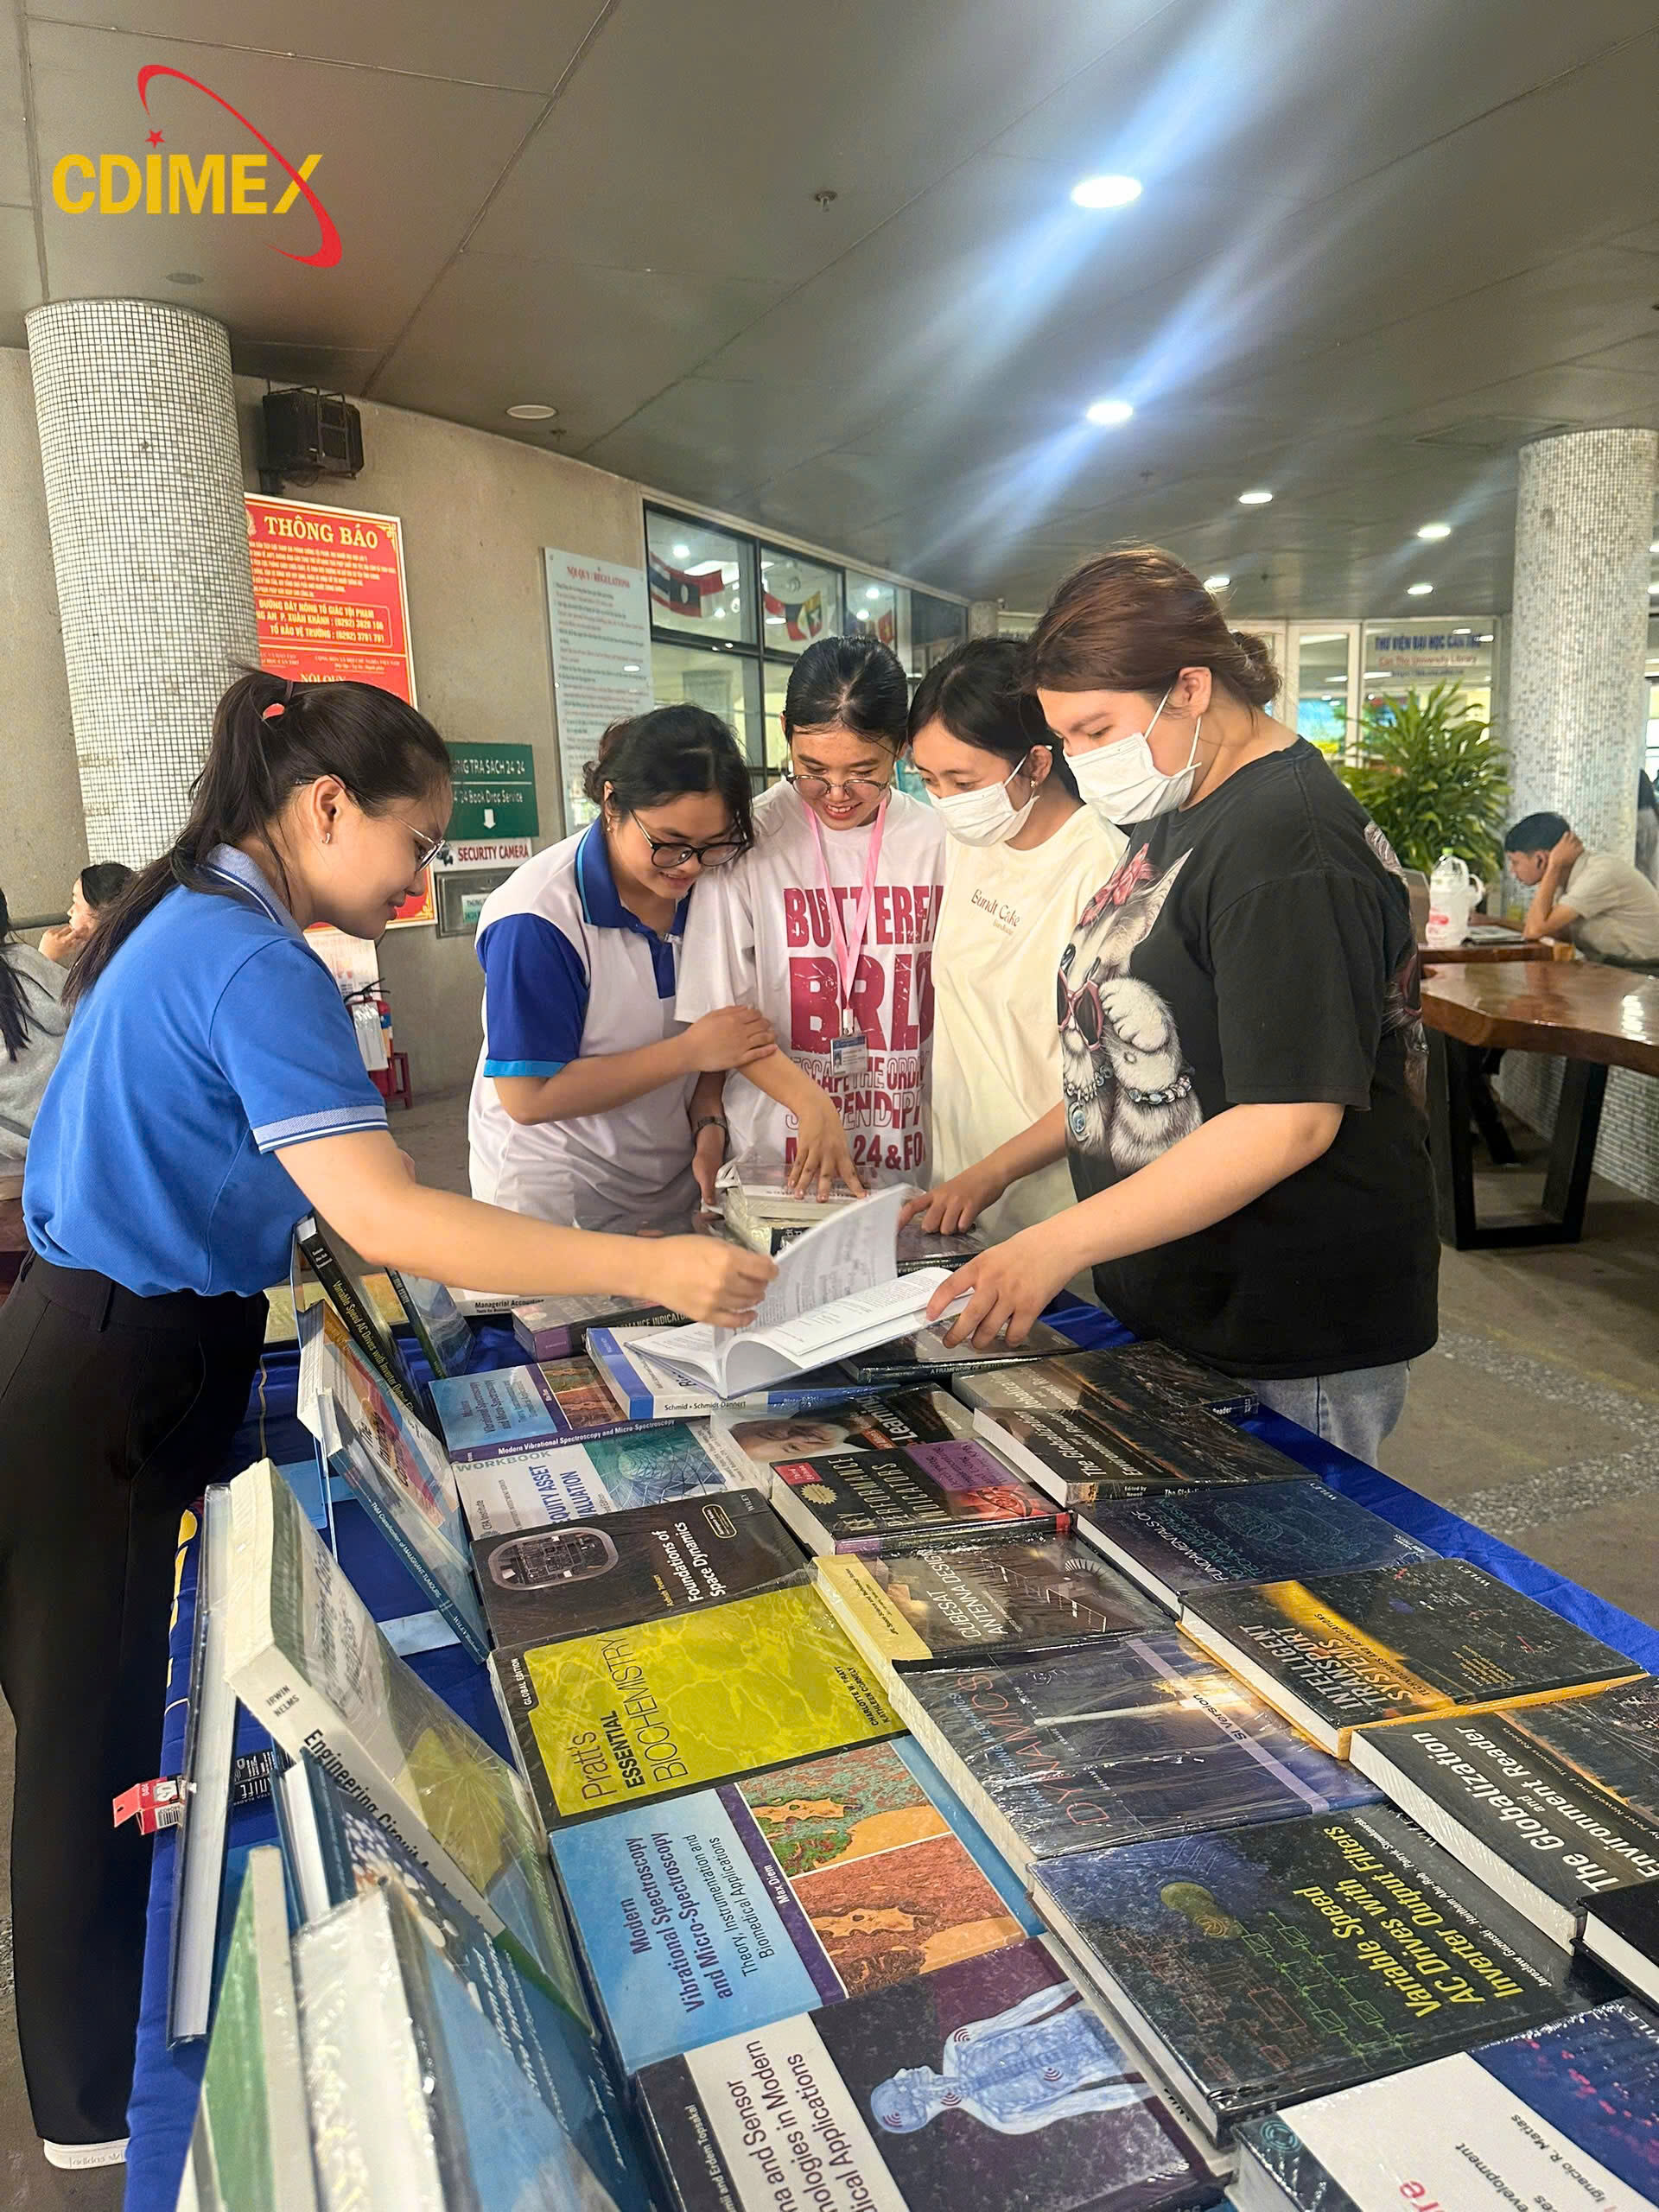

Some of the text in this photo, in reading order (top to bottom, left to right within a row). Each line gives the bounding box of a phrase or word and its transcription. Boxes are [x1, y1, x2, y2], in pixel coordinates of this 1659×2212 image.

[264, 515, 378, 550] THÔNG BÁO
[458, 844, 529, 861] SECURITY CAMERA
[474, 1299, 510, 1310] Managerial
[332, 1280, 349, 1306] Variable
[346, 1304, 359, 1325] Speed
[362, 1332, 376, 1351] Drives
[372, 1351, 383, 1363] with
[379, 1362, 396, 1387] Inverter
[664, 1402, 688, 1411] Schmid
[857, 1395, 918, 1446] Learning
[456, 1451, 552, 1472] WORKBOOK
[498, 1444, 524, 1455] Modern
[524, 1438, 559, 1451] Vibrational
[560, 1431, 601, 1444] Spectroscopy
[602, 1428, 614, 1438] and
[1014, 1410, 1107, 1478] The Globalization
[1079, 1432, 1143, 1477] Environment
[528, 1465, 557, 1493] ASSET
[740, 1493, 756, 1512] WILEY
[828, 1457, 907, 1529] PERFORMANCE
[871, 1463, 952, 1523] INDICATORS
[1310, 1482, 1338, 1501] WILEY
[652, 1530, 704, 1603] Foundations of
[674, 1522, 727, 1597] Space Dynamics
[1147, 1522, 1229, 1582] FUNDAMENTALS
[1454, 1563, 1491, 1587] WILEY
[926, 1590, 973, 1640] CUBESAT
[954, 1585, 1008, 1636] ANTENNA
[1314, 1612, 1359, 1643] APPLICATIONS
[511, 1658, 533, 1707] GLOBAL EDITION
[834, 1665, 850, 1685] PRATT
[1238, 1624, 1353, 1711] INTELLIGENT
[1275, 1627, 1376, 1709] TRANSPORT
[1316, 1638, 1414, 1703] SYSTEMS
[1374, 1654, 1428, 1696] TECHNOLOGIES
[264, 1685, 291, 1707] IRWIN
[273, 1694, 301, 1718] NELMS
[601, 1637, 690, 1783] BIOCHEMISTRY
[844, 1666, 891, 1724] KATHLEEN CORNELY
[849, 1690, 880, 1726] CHARLOTTE
[1193, 1694, 1247, 1742] SI Version
[304, 1728, 378, 1813] Engineering
[566, 1731, 617, 1801] Pratt's
[600, 1709, 646, 1789] ESSENTIAL
[957, 1674, 1111, 1827] DYNAMICS
[1455, 1726, 1531, 1780] Reader
[1412, 1732, 1620, 1892] The Globalization
[1516, 1795, 1546, 1813] and
[763, 1864, 791, 1905] Max Diem
[1389, 1848, 1412, 1870] Patryk
[652, 1831, 734, 1999] and Micro-Spectroscopy
[690, 1832, 759, 1978] Theory, Instrumentation and
[709, 1836, 776, 1960] Biomedical Applications
[1324, 1825, 1525, 1999] Inverter Output Filters
[1452, 1899, 1480, 1929] Haitham
[620, 1897, 652, 1955] Modern
[625, 1837, 706, 2013] Vibrational Spectroscopy
[1334, 1878, 1486, 2007] AC Drives with
[1479, 1925, 1519, 1960] Guzinski
[1294, 1886, 1442, 2018] Variable Speed
[746, 2039, 793, 2132] in Modern
[787, 2052, 855, 2167] Applications
[685, 2104, 713, 2142] Topsakal
[727, 2079, 785, 2185] and Sensor
[1510, 2114, 1548, 2150] Matias
[701, 2139, 724, 2177] Erdem
[1561, 2161, 1607, 2204] Ignacio
[714, 2172, 732, 2198] and
